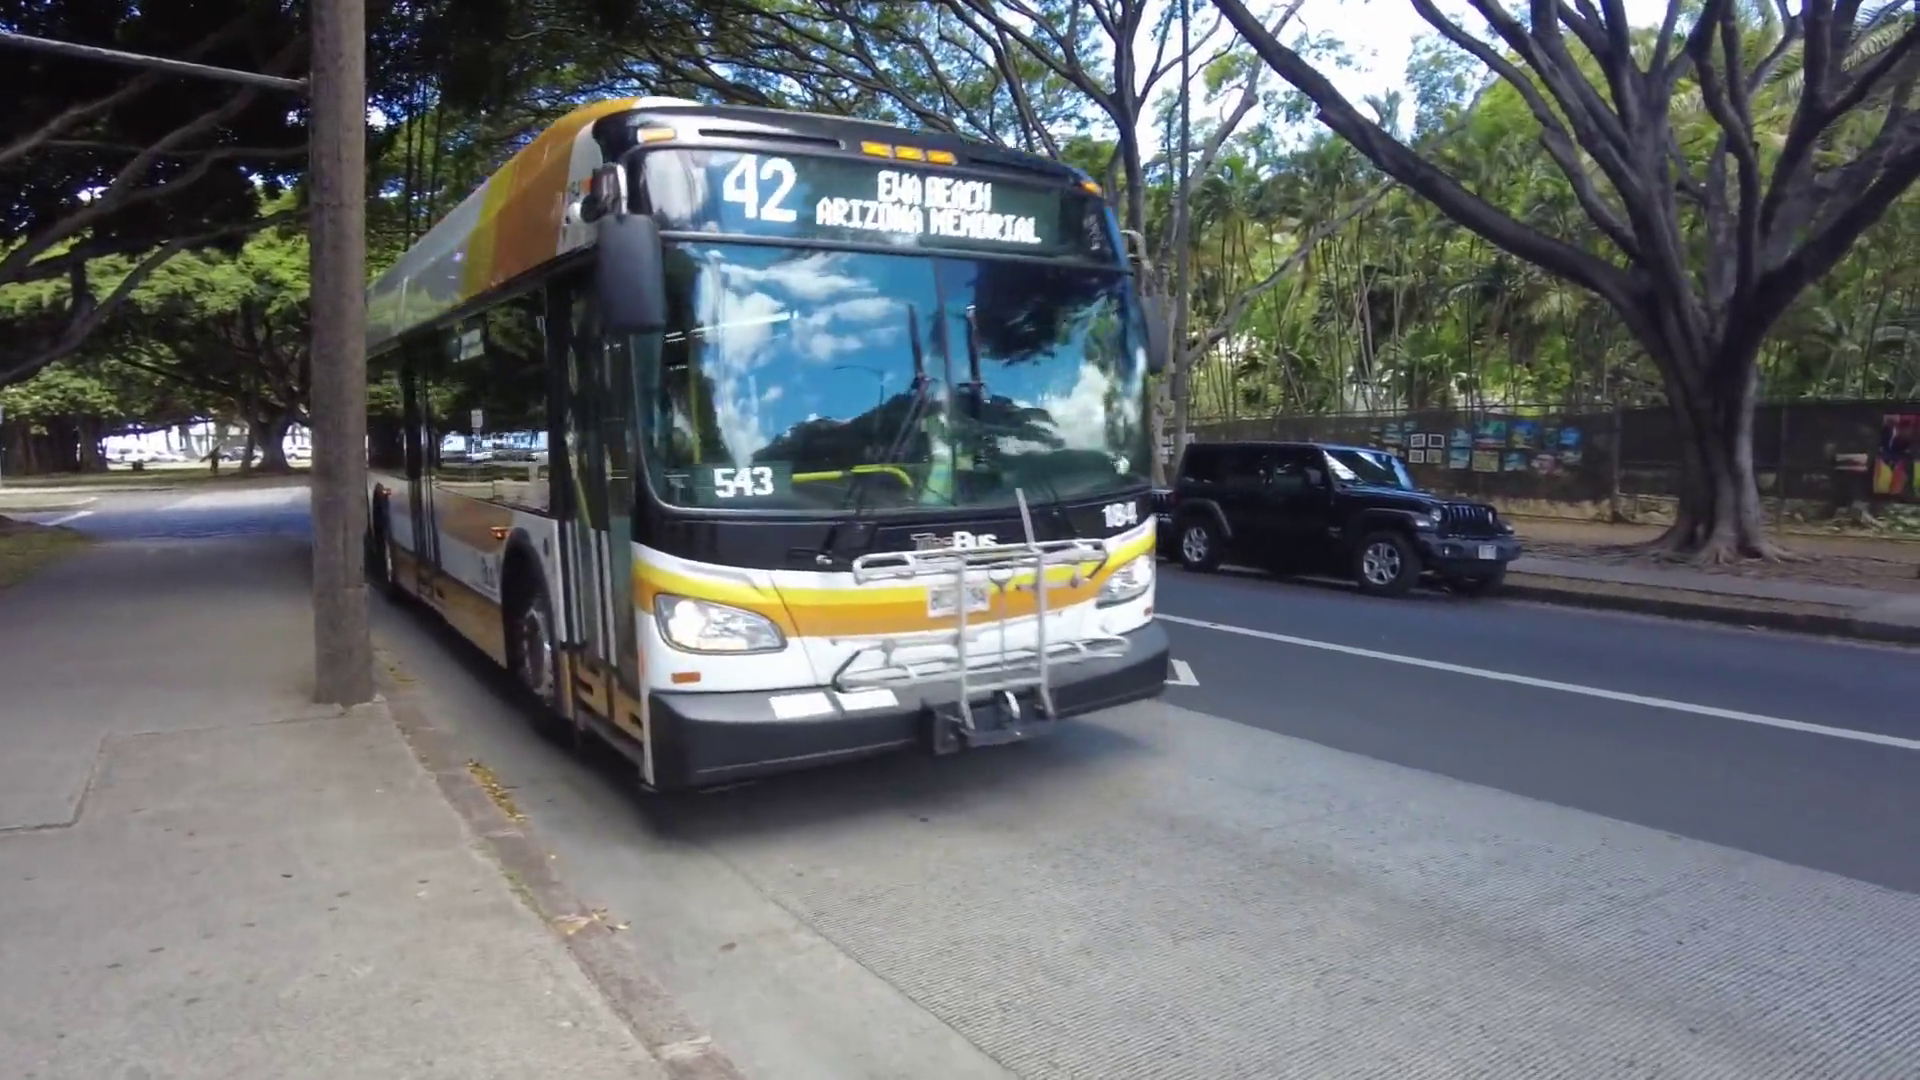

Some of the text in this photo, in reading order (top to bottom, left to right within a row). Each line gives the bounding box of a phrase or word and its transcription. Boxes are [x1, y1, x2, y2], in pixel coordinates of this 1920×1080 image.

[722, 154, 797, 222] 42
[877, 169, 992, 211] EWA BEACH
[815, 196, 1042, 244] ARIZONA MEMORIAL
[712, 466, 775, 498] 543
